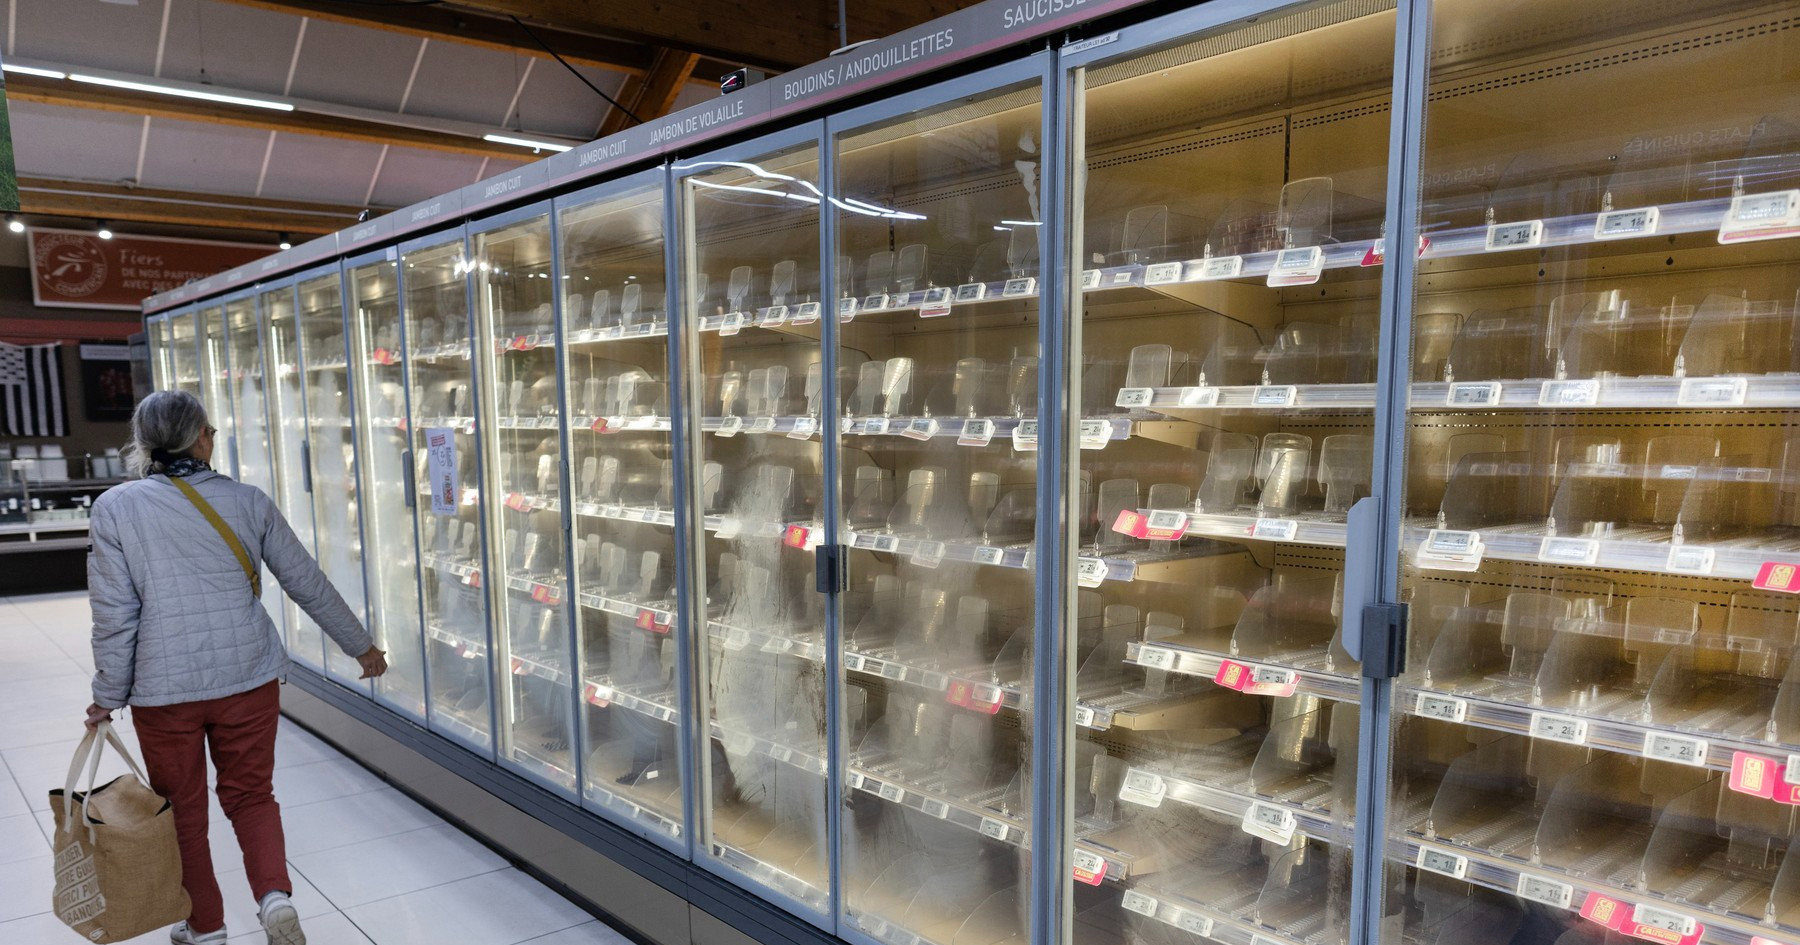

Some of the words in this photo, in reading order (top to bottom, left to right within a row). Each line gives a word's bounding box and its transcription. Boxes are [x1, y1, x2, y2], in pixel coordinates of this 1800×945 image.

[1004, 0, 1086, 28] SAUCIS
[784, 69, 835, 100] BOUDINS
[837, 64, 843, 85] /
[845, 28, 954, 80] ANDOUILLETTES
[649, 121, 684, 146] JAMBON
[686, 118, 698, 133] DE
[699, 100, 744, 129] VOLAILLE
[579, 145, 608, 167] JAMBON
[609, 139, 628, 157] CUIT
[484, 180, 506, 199] JAMBON
[507, 175, 522, 192] CUIT
[120, 248, 164, 266] Fiers
[121, 268, 135, 277] DE
[138, 268, 161, 279] NOS
[122, 280, 150, 289] AVEC
